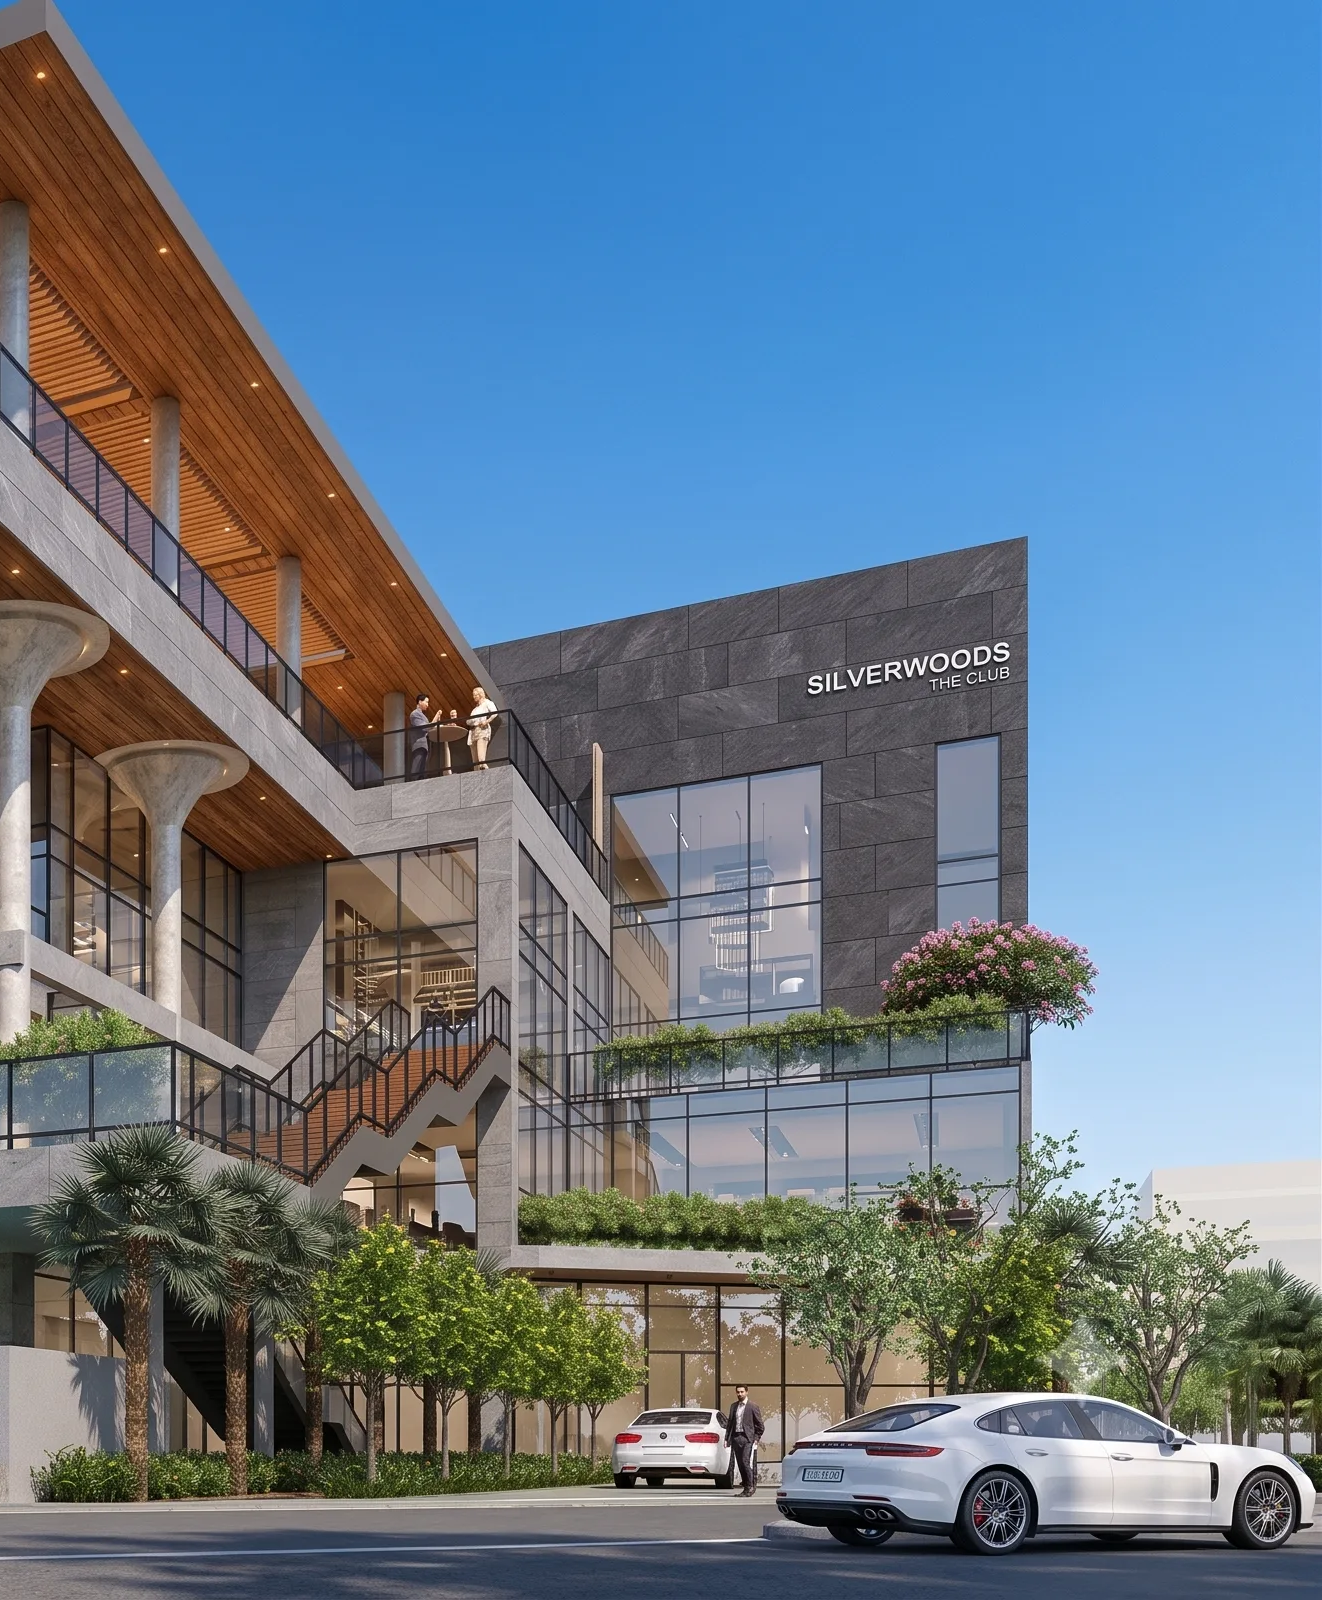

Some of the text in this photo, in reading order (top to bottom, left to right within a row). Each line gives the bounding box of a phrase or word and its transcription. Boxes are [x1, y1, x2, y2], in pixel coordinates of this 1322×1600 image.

[806, 641, 1011, 695] SILVERWOODS
[928, 666, 1010, 691] THE CLUB
